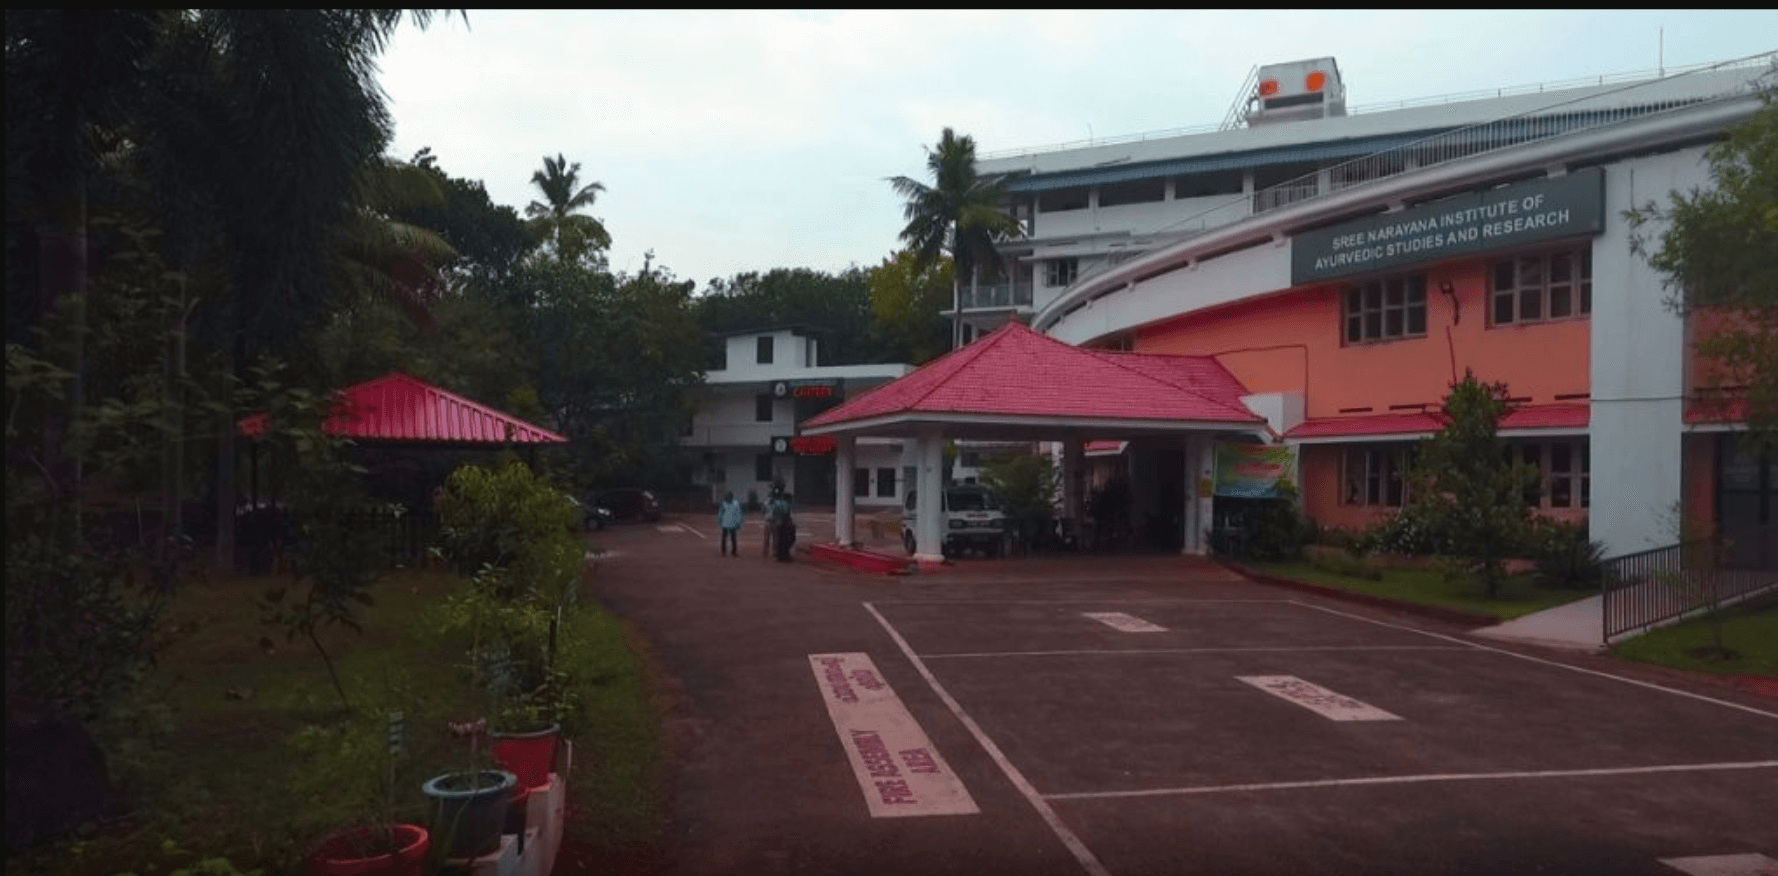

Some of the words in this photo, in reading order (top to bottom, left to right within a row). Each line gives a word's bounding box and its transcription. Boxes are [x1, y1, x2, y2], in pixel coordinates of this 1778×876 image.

[1315, 247, 1383, 271] AYURVEDIC
[1386, 233, 1444, 257] STUDIES
[1446, 226, 1479, 245] AND
[1482, 210, 1570, 237] RESEARCH
[1332, 233, 1365, 250] SREE
[1367, 219, 1438, 242] NARAYANA
[1440, 200, 1518, 228] INSTITUTE
[1522, 194, 1544, 210] OF
[849, 729, 903, 778] ASSEMBLY
[897, 748, 941, 773] AREA
[874, 779, 918, 804] FIRE
